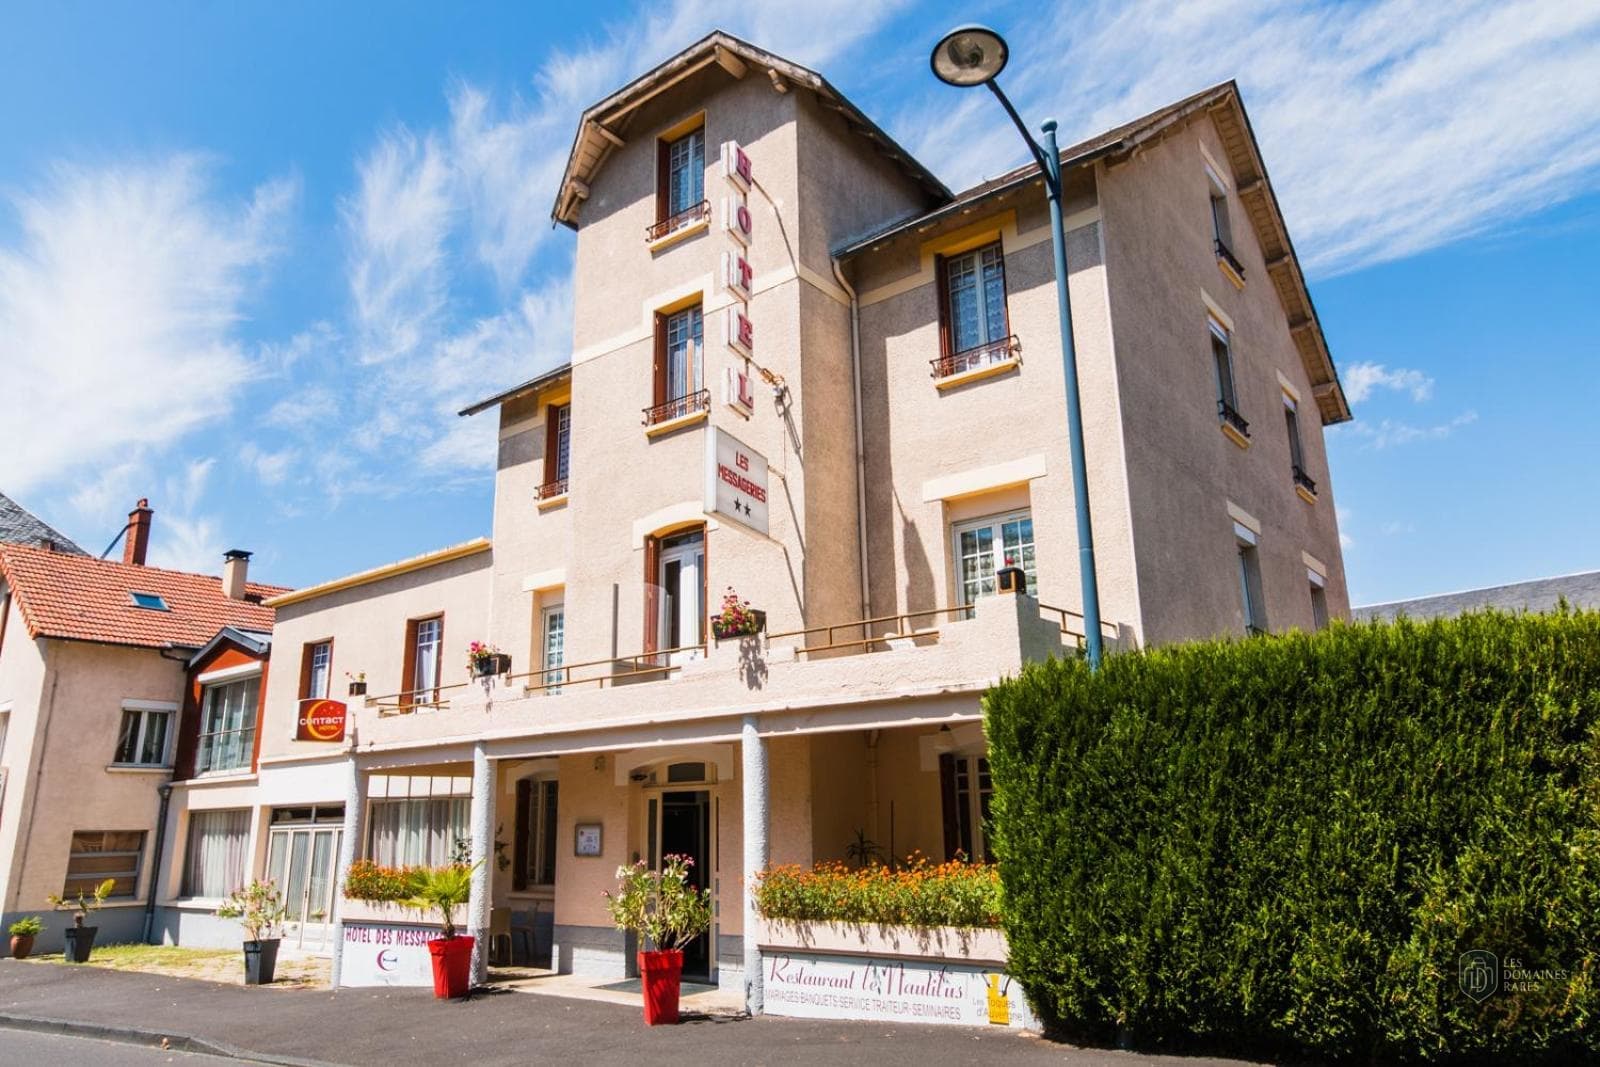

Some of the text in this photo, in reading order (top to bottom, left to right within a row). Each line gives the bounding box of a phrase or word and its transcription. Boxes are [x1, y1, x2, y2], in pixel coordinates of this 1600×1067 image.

[736, 147, 753, 410] HOTEL
[736, 450, 749, 472] LES
[718, 462, 767, 503] MESSAGERIES
[376, 928, 393, 945] DES
[770, 954, 963, 998] Restaurant le Nautilus
